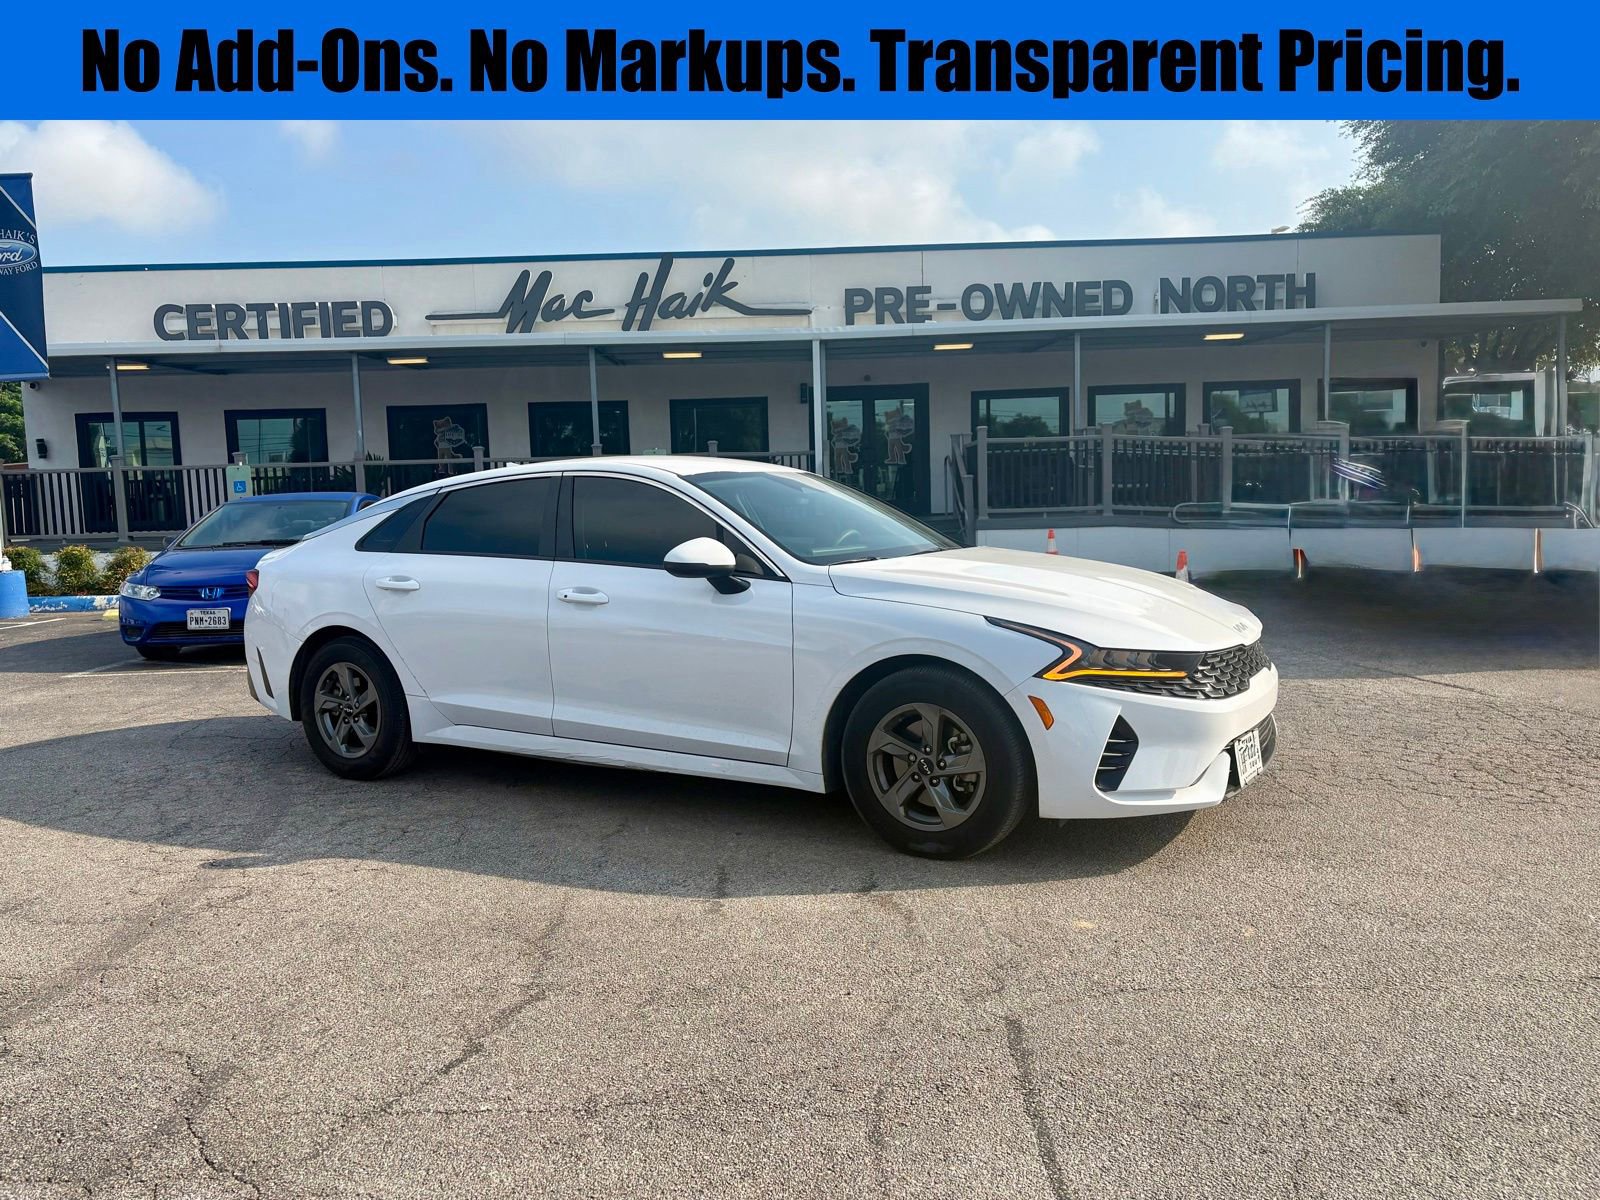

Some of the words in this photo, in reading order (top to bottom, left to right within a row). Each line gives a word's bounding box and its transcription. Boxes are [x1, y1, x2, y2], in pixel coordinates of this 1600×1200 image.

[15, 261, 38, 274] FORD
[153, 300, 394, 341] CERTIFIED
[425, 269, 615, 334] Mac
[621, 253, 812, 331] Haik
[844, 279, 1133, 325] PRE-OWNED
[1159, 272, 1317, 314] NORTH
